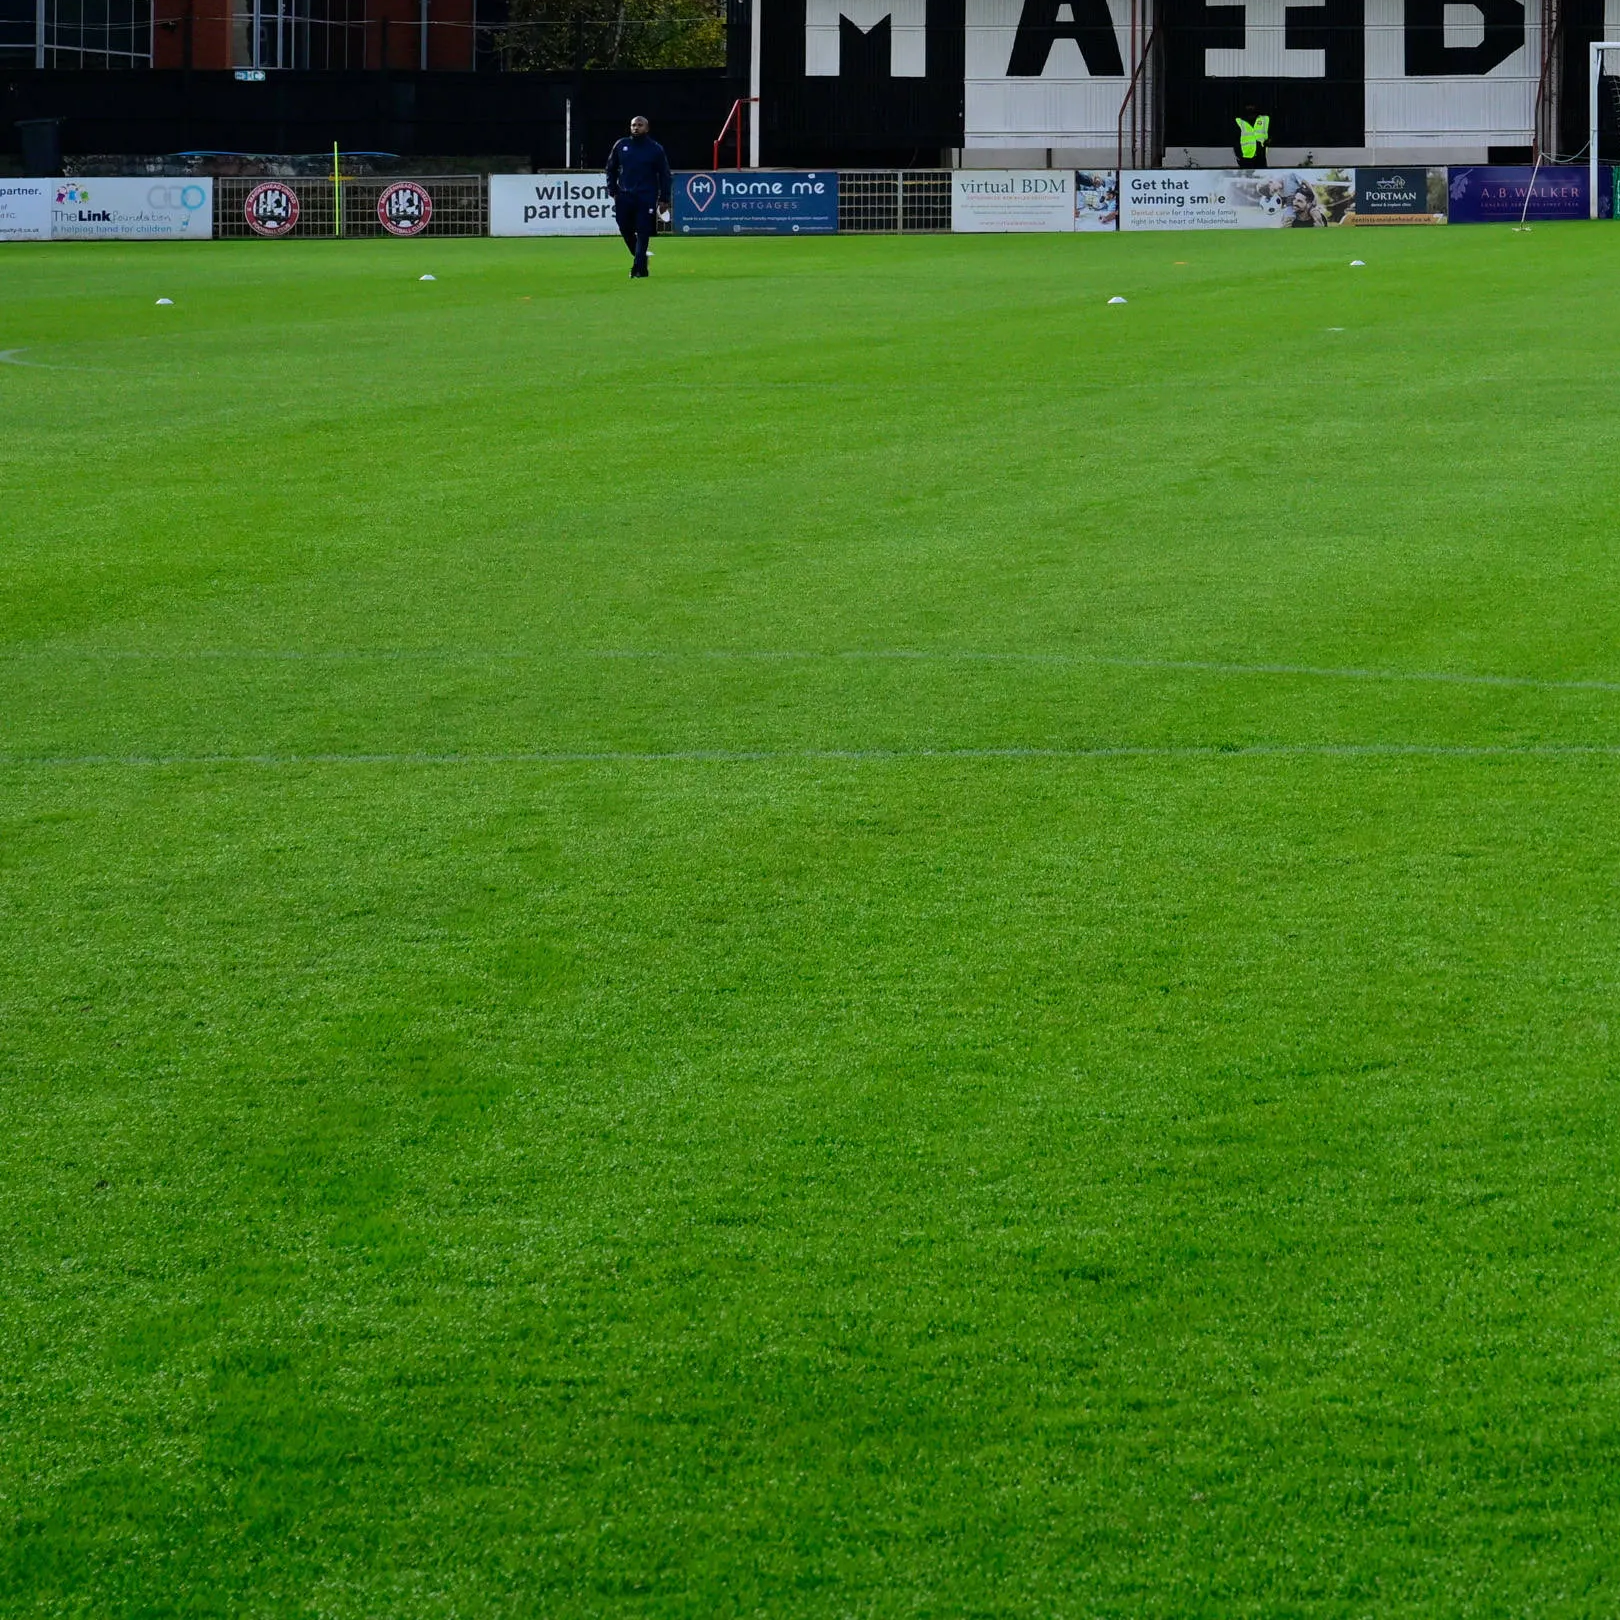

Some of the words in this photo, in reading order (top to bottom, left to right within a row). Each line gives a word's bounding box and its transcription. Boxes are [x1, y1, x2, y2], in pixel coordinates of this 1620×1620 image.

[722, 179, 783, 194] home
[792, 182, 825, 194] me
[961, 178, 1014, 194] virtual
[1022, 179, 1065, 194] BDM
[1131, 179, 1157, 190] Get
[1161, 178, 1189, 190] that
[0, 187, 42, 197] partner.
[536, 181, 609, 200] wilson
[1131, 193, 1185, 207] winning
[1217, 209, 1237, 217] family
[1131, 218, 1147, 226] right
[61, 224, 94, 234] helping
[96, 224, 120, 233] hand
[122, 224, 134, 233] for
[136, 224, 172, 233] children
